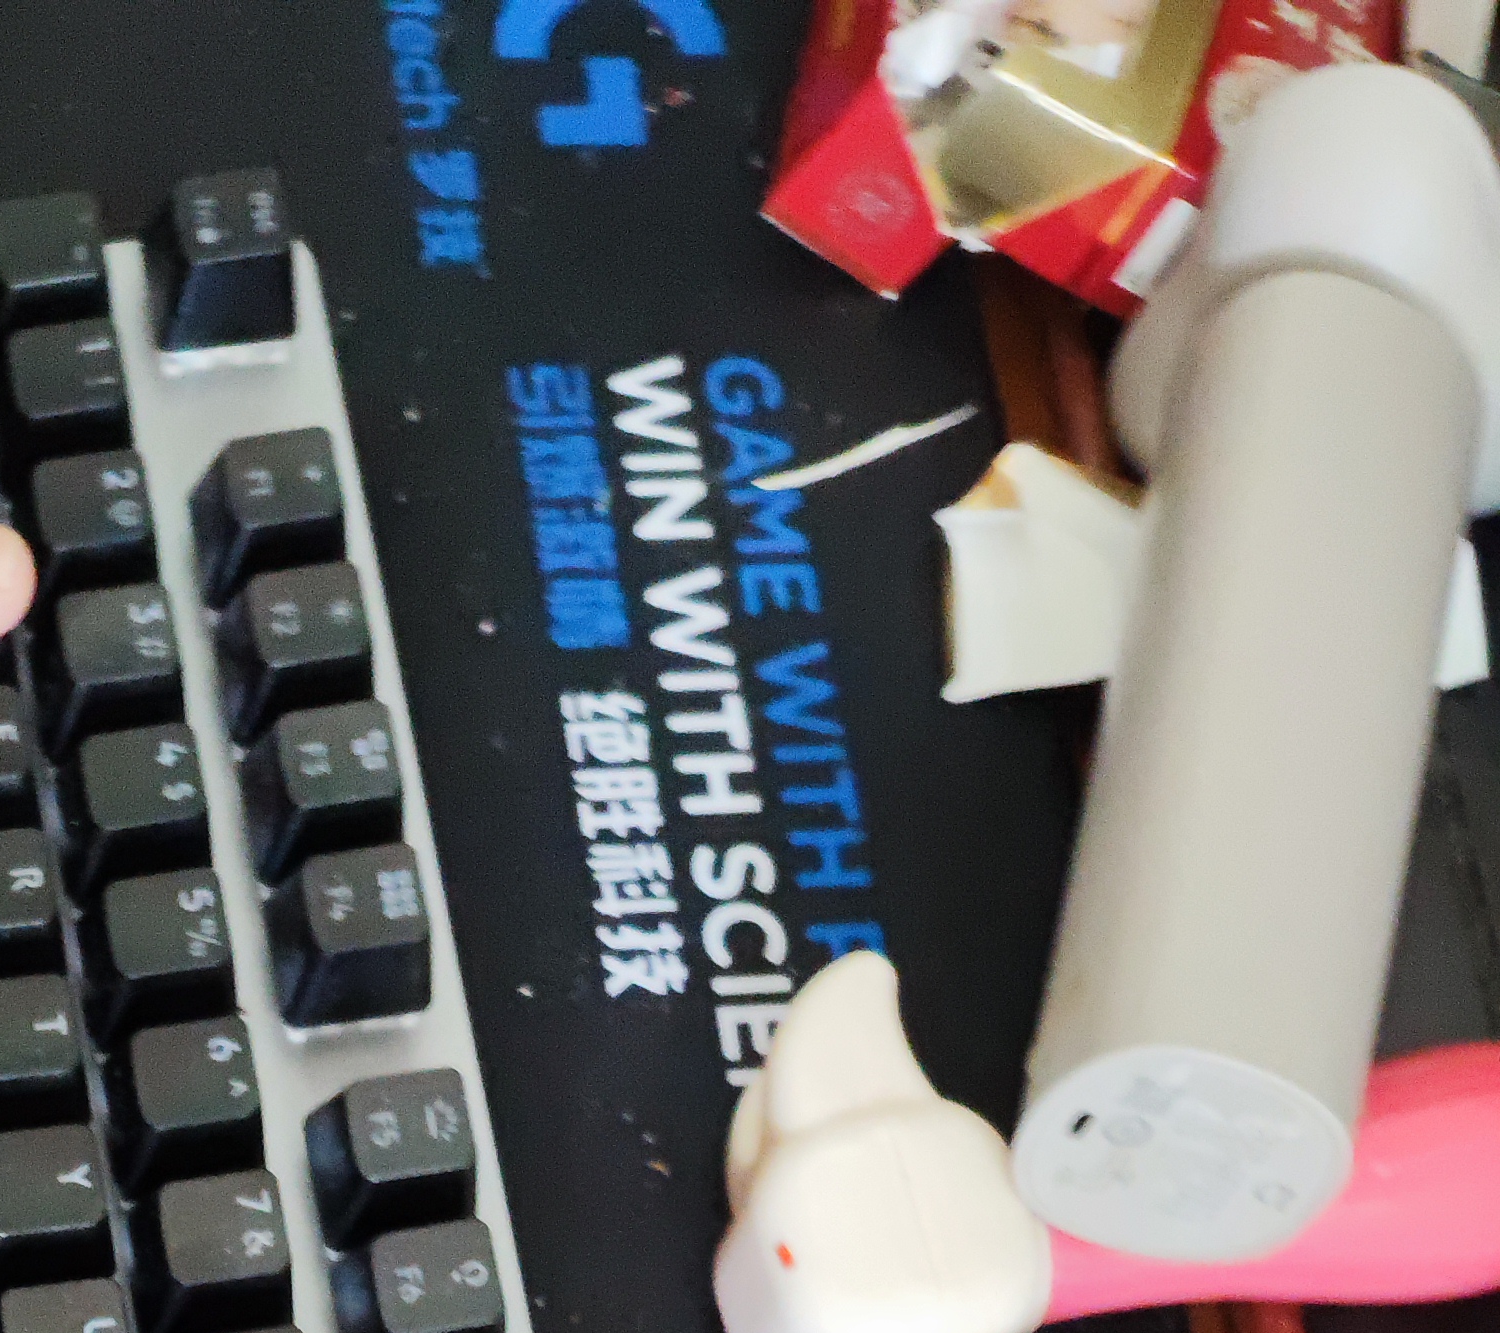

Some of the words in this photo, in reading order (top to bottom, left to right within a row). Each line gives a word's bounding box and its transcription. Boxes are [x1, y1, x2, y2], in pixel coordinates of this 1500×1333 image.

[607, 356, 714, 541] WIN
[101, 469, 138, 489] 2
[704, 356, 821, 617] GAME
[645, 567, 762, 825] WITH
[156, 741, 188, 767] 4
[755, 641, 871, 888] WITH
[560, 685, 695, 997] 绝胜科技
[8, 866, 44, 891] R
[178, 888, 215, 912] 5
[33, 1013, 69, 1036] T
[207, 1036, 242, 1062] 6
[56, 1164, 93, 1189] Y
[235, 1189, 273, 1213] 7
[394, 1265, 425, 1304] F6
